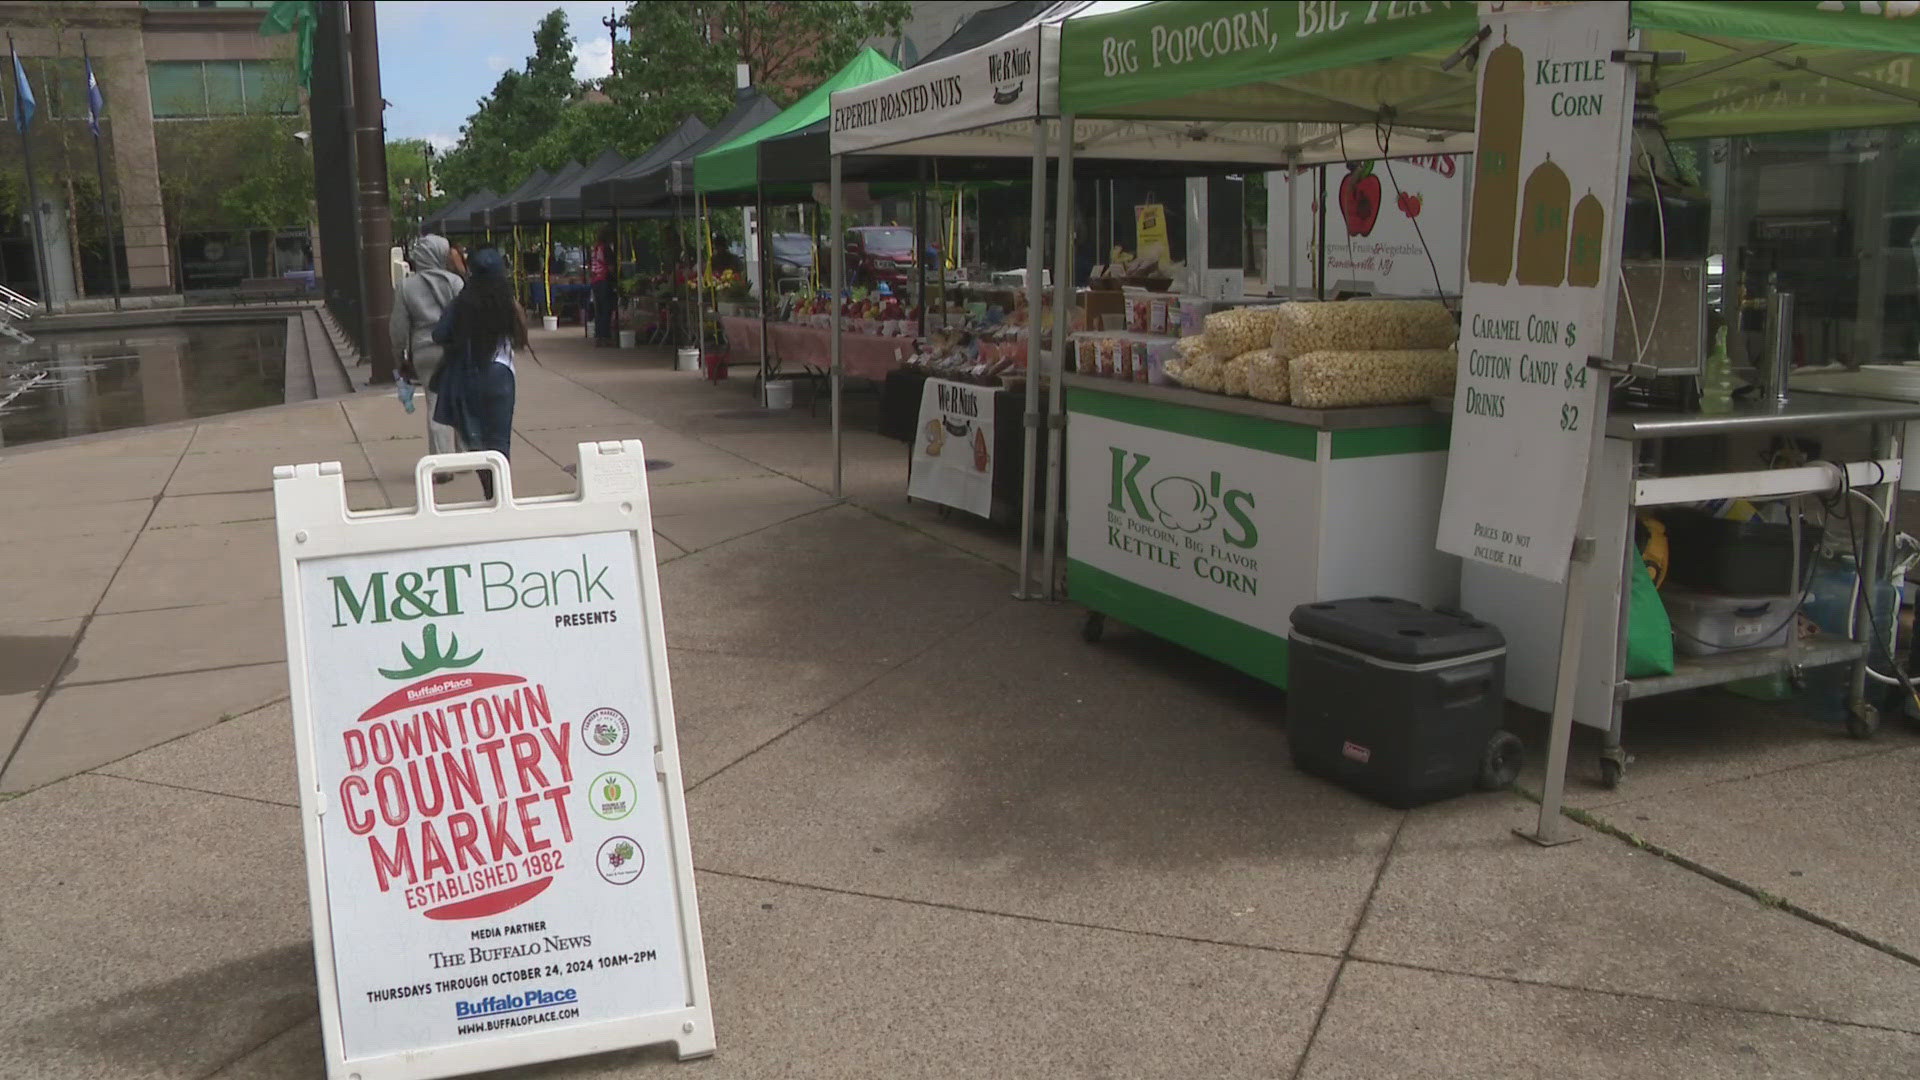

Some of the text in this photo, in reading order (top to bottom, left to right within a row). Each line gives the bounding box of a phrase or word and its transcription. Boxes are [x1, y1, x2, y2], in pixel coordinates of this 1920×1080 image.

[1102, 36, 1139, 77] BIG
[1151, 7, 1278, 68] POPCORN,
[1536, 59, 1606, 85] KETTLE
[834, 96, 879, 133] EXPERTLY
[880, 85, 929, 123] ROASTED
[930, 75, 963, 111] NUTS
[1551, 92, 1603, 117] CORN
[1472, 313, 1576, 348] CARAMEL CORN $
[1469, 349, 1511, 380] COTTON
[1520, 354, 1558, 386] CANDY
[1466, 386, 1579, 432] DRINKS $2
[1128, 518, 1179, 547] POPCORN,
[1184, 536, 1204, 553] BIG
[1211, 544, 1258, 571] FLAVOR
[1473, 522, 1531, 548] PRICES DO NOT
[1107, 525, 1258, 596] KETTLE CORN
[1473, 546, 1504, 563] INCLUDE
[327, 553, 615, 628] M&T Bank
[555, 610, 617, 628] PRESENTS
[407, 677, 473, 699] Buffalo Place
[342, 683, 552, 772] DOWNTOWN
[339, 721, 573, 835] COUNTRY
[368, 785, 573, 892] MARKET
[405, 850, 565, 910] ESTABLISHED 1982
[471, 920, 546, 940] MEDIA PARTNER
[428, 933, 592, 969] THE BUFFALO NEWS
[366, 950, 657, 1003] THURSDAYS THROUGH OCTOBER 24, 2024 10AM-2PM
[455, 987, 578, 1017] Buffalo Place
[457, 1007, 580, 1036] WWW.BUFFALOPLACE.COM
